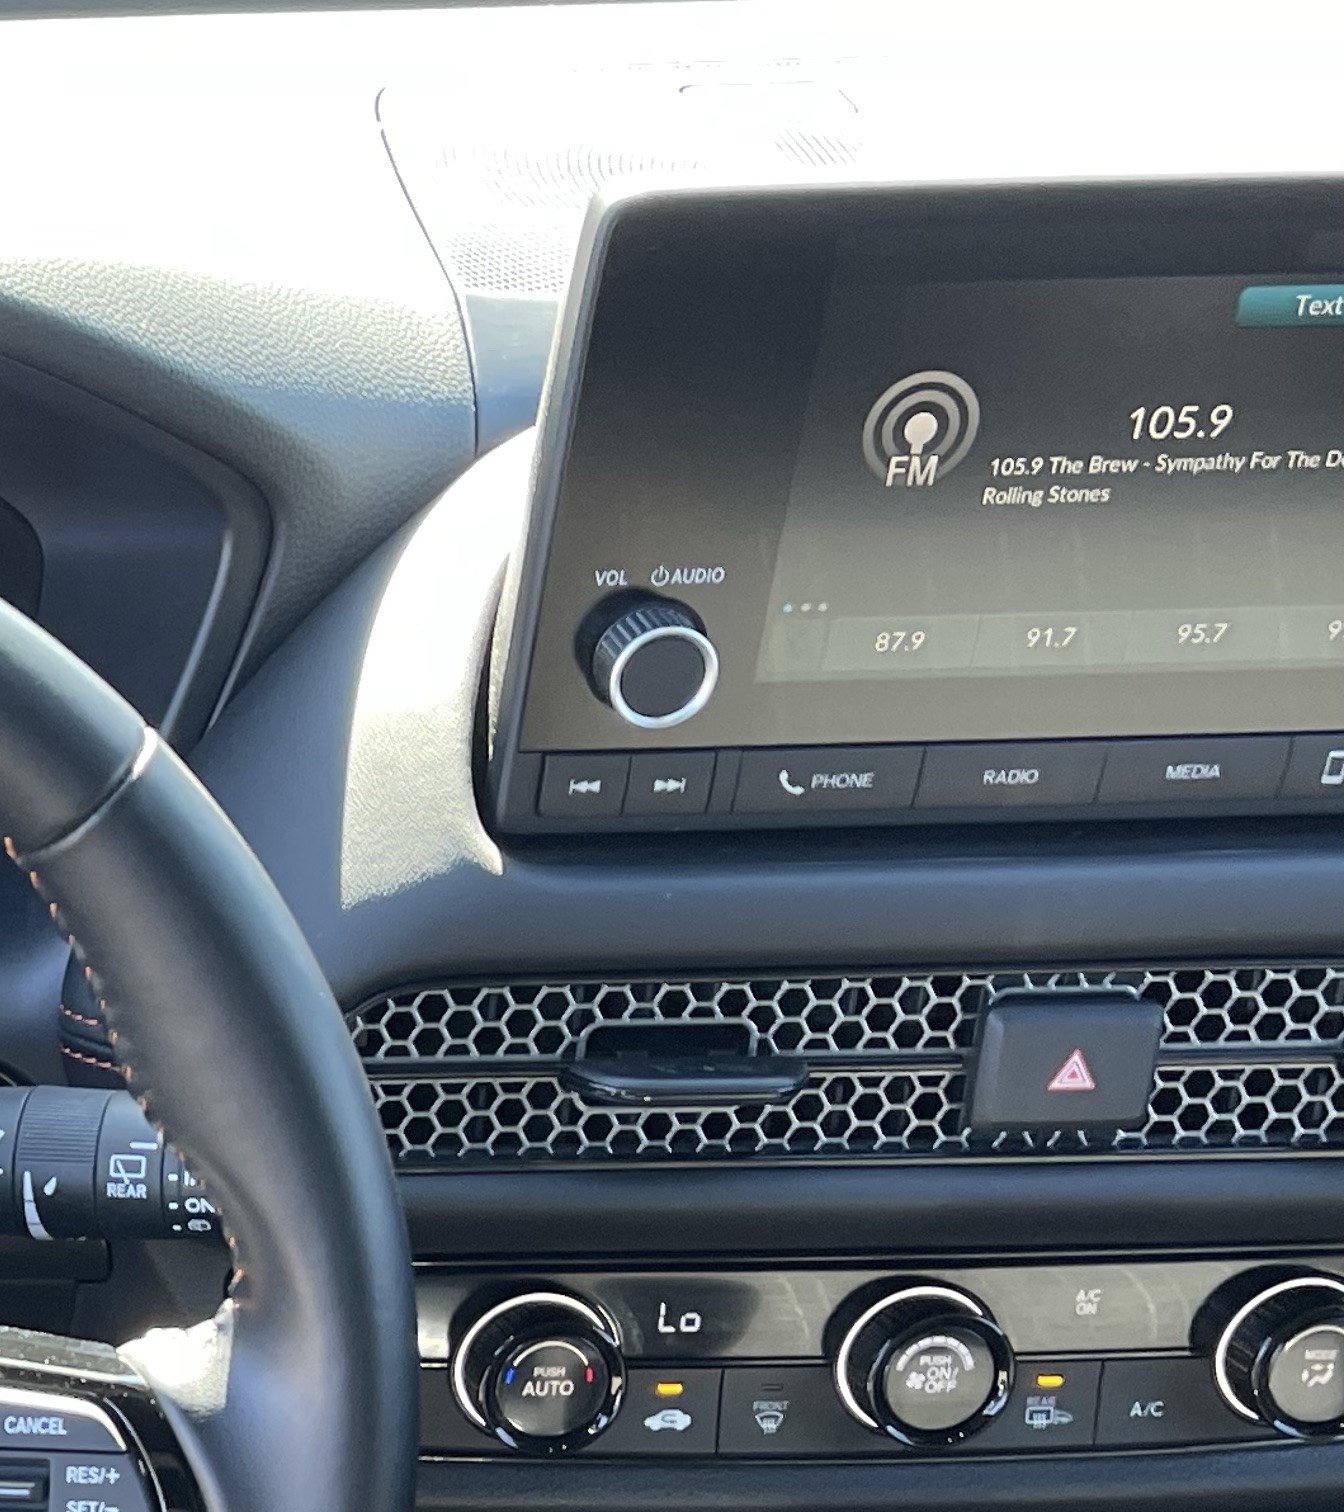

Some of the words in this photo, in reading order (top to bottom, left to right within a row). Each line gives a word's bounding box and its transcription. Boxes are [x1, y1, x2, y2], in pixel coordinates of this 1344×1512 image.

[1295, 294, 1344, 317] Text
[1128, 404, 1234, 441] 105.9
[884, 454, 939, 487] FM
[989, 456, 1044, 477] 105.9
[1049, 455, 1084, 475] The
[1088, 454, 1138, 475] Brew
[1154, 450, 1246, 475] Sympathy
[1249, 450, 1283, 469] For
[1287, 448, 1321, 469] The
[981, 485, 1044, 507] Rolling
[1047, 484, 1111, 505] Stones
[594, 569, 628, 587] VOL
[671, 566, 726, 585] AUDIO
[1025, 626, 1078, 649] 91.7
[1176, 622, 1229, 645] 95.7
[1328, 619, 1344, 641] 9
[874, 630, 926, 653] 87.9
[811, 771, 875, 791] PHONE
[982, 768, 1040, 785] RADIO
[1164, 763, 1221, 780] MEDIA
[106, 1182, 147, 1200] REAR
[1074, 1289, 1102, 1302] A/C
[1074, 1302, 1098, 1317] ON
[919, 1355, 952, 1367] PUSH
[532, 1366, 566, 1379] PUSH
[521, 1379, 575, 1398] AUTO
[924, 1379, 957, 1393] OFF
[1129, 1401, 1166, 1418] A/C
[3, 1415, 68, 1437] CANCEL
